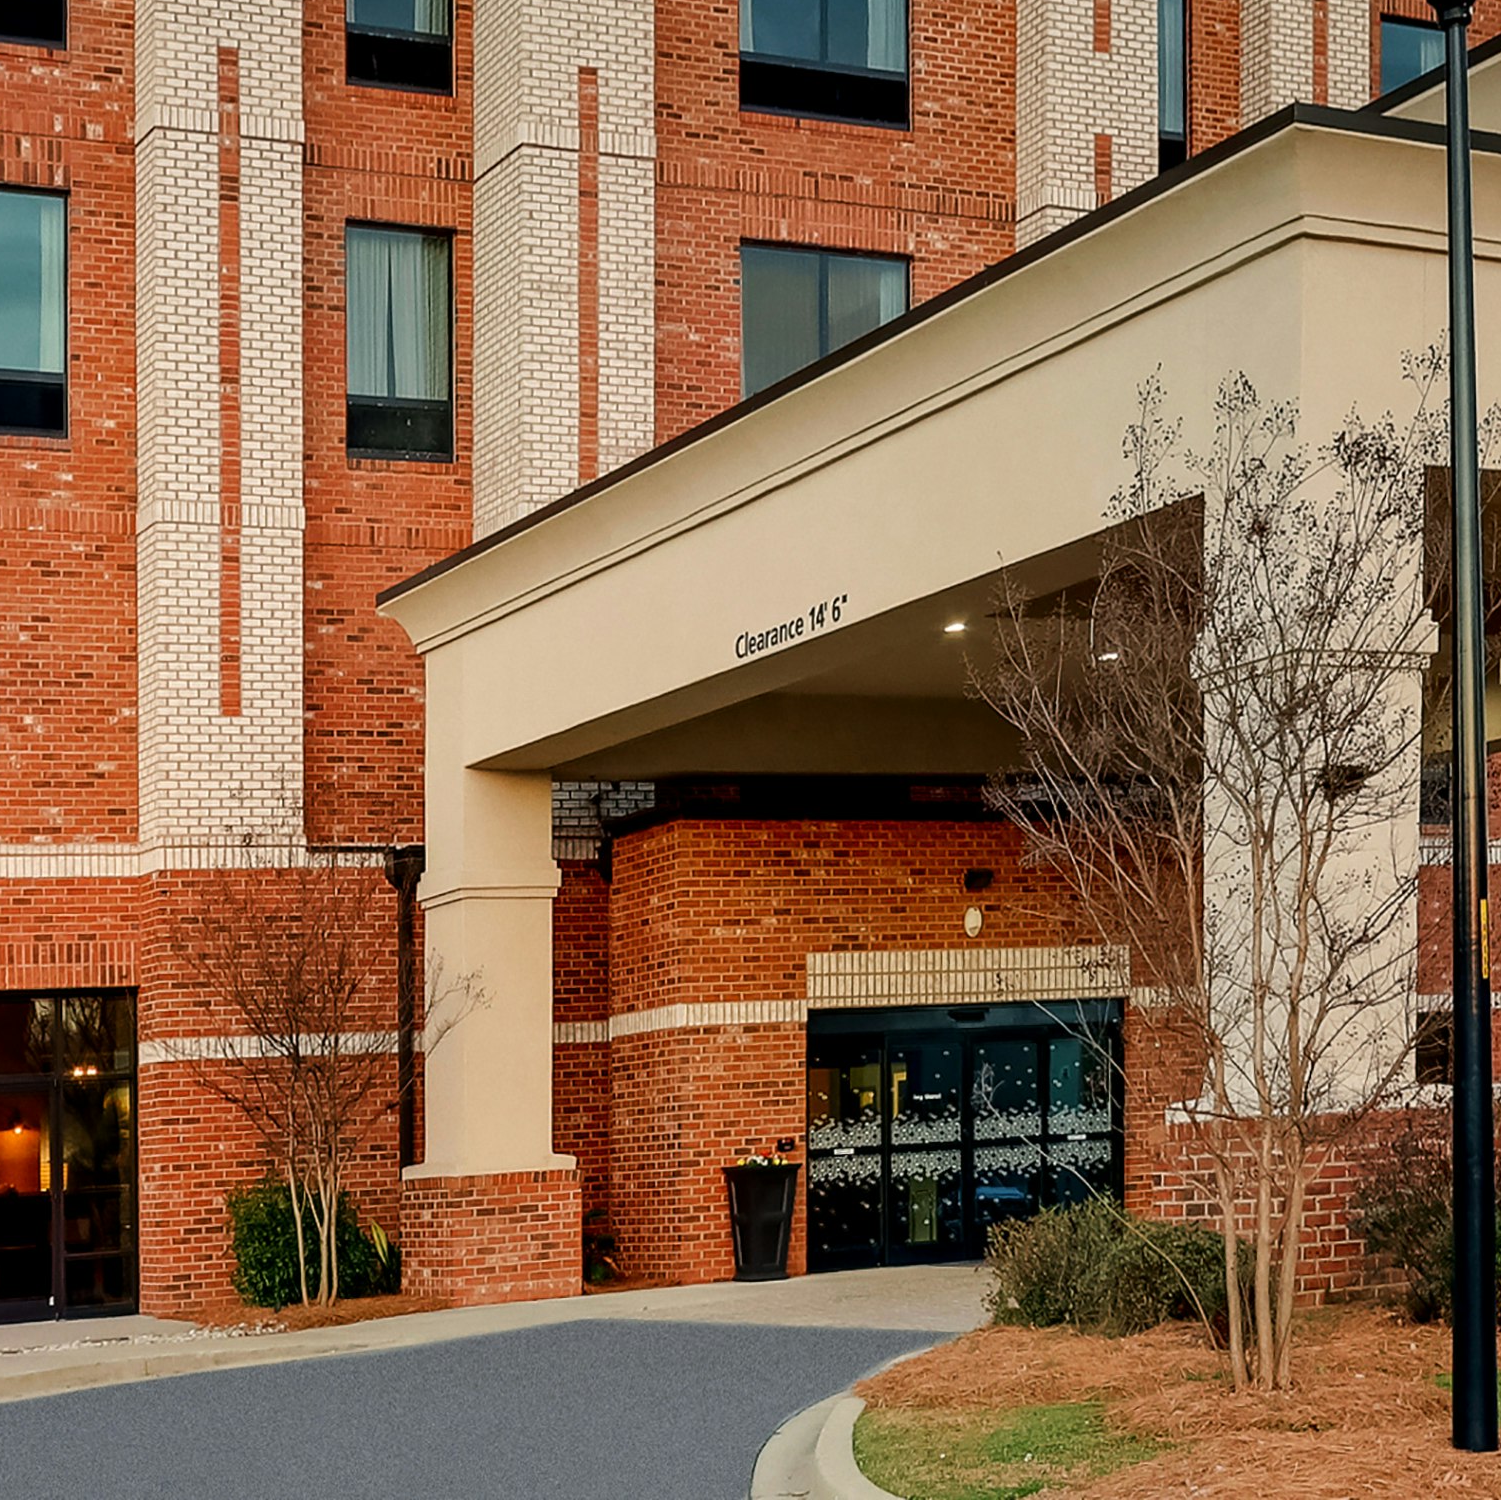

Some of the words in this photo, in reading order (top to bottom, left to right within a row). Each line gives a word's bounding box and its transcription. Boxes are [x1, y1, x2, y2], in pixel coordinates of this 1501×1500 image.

[735, 617, 804, 658] Clearance
[809, 602, 828, 631] 14'
[832, 594, 848, 622] 6"
